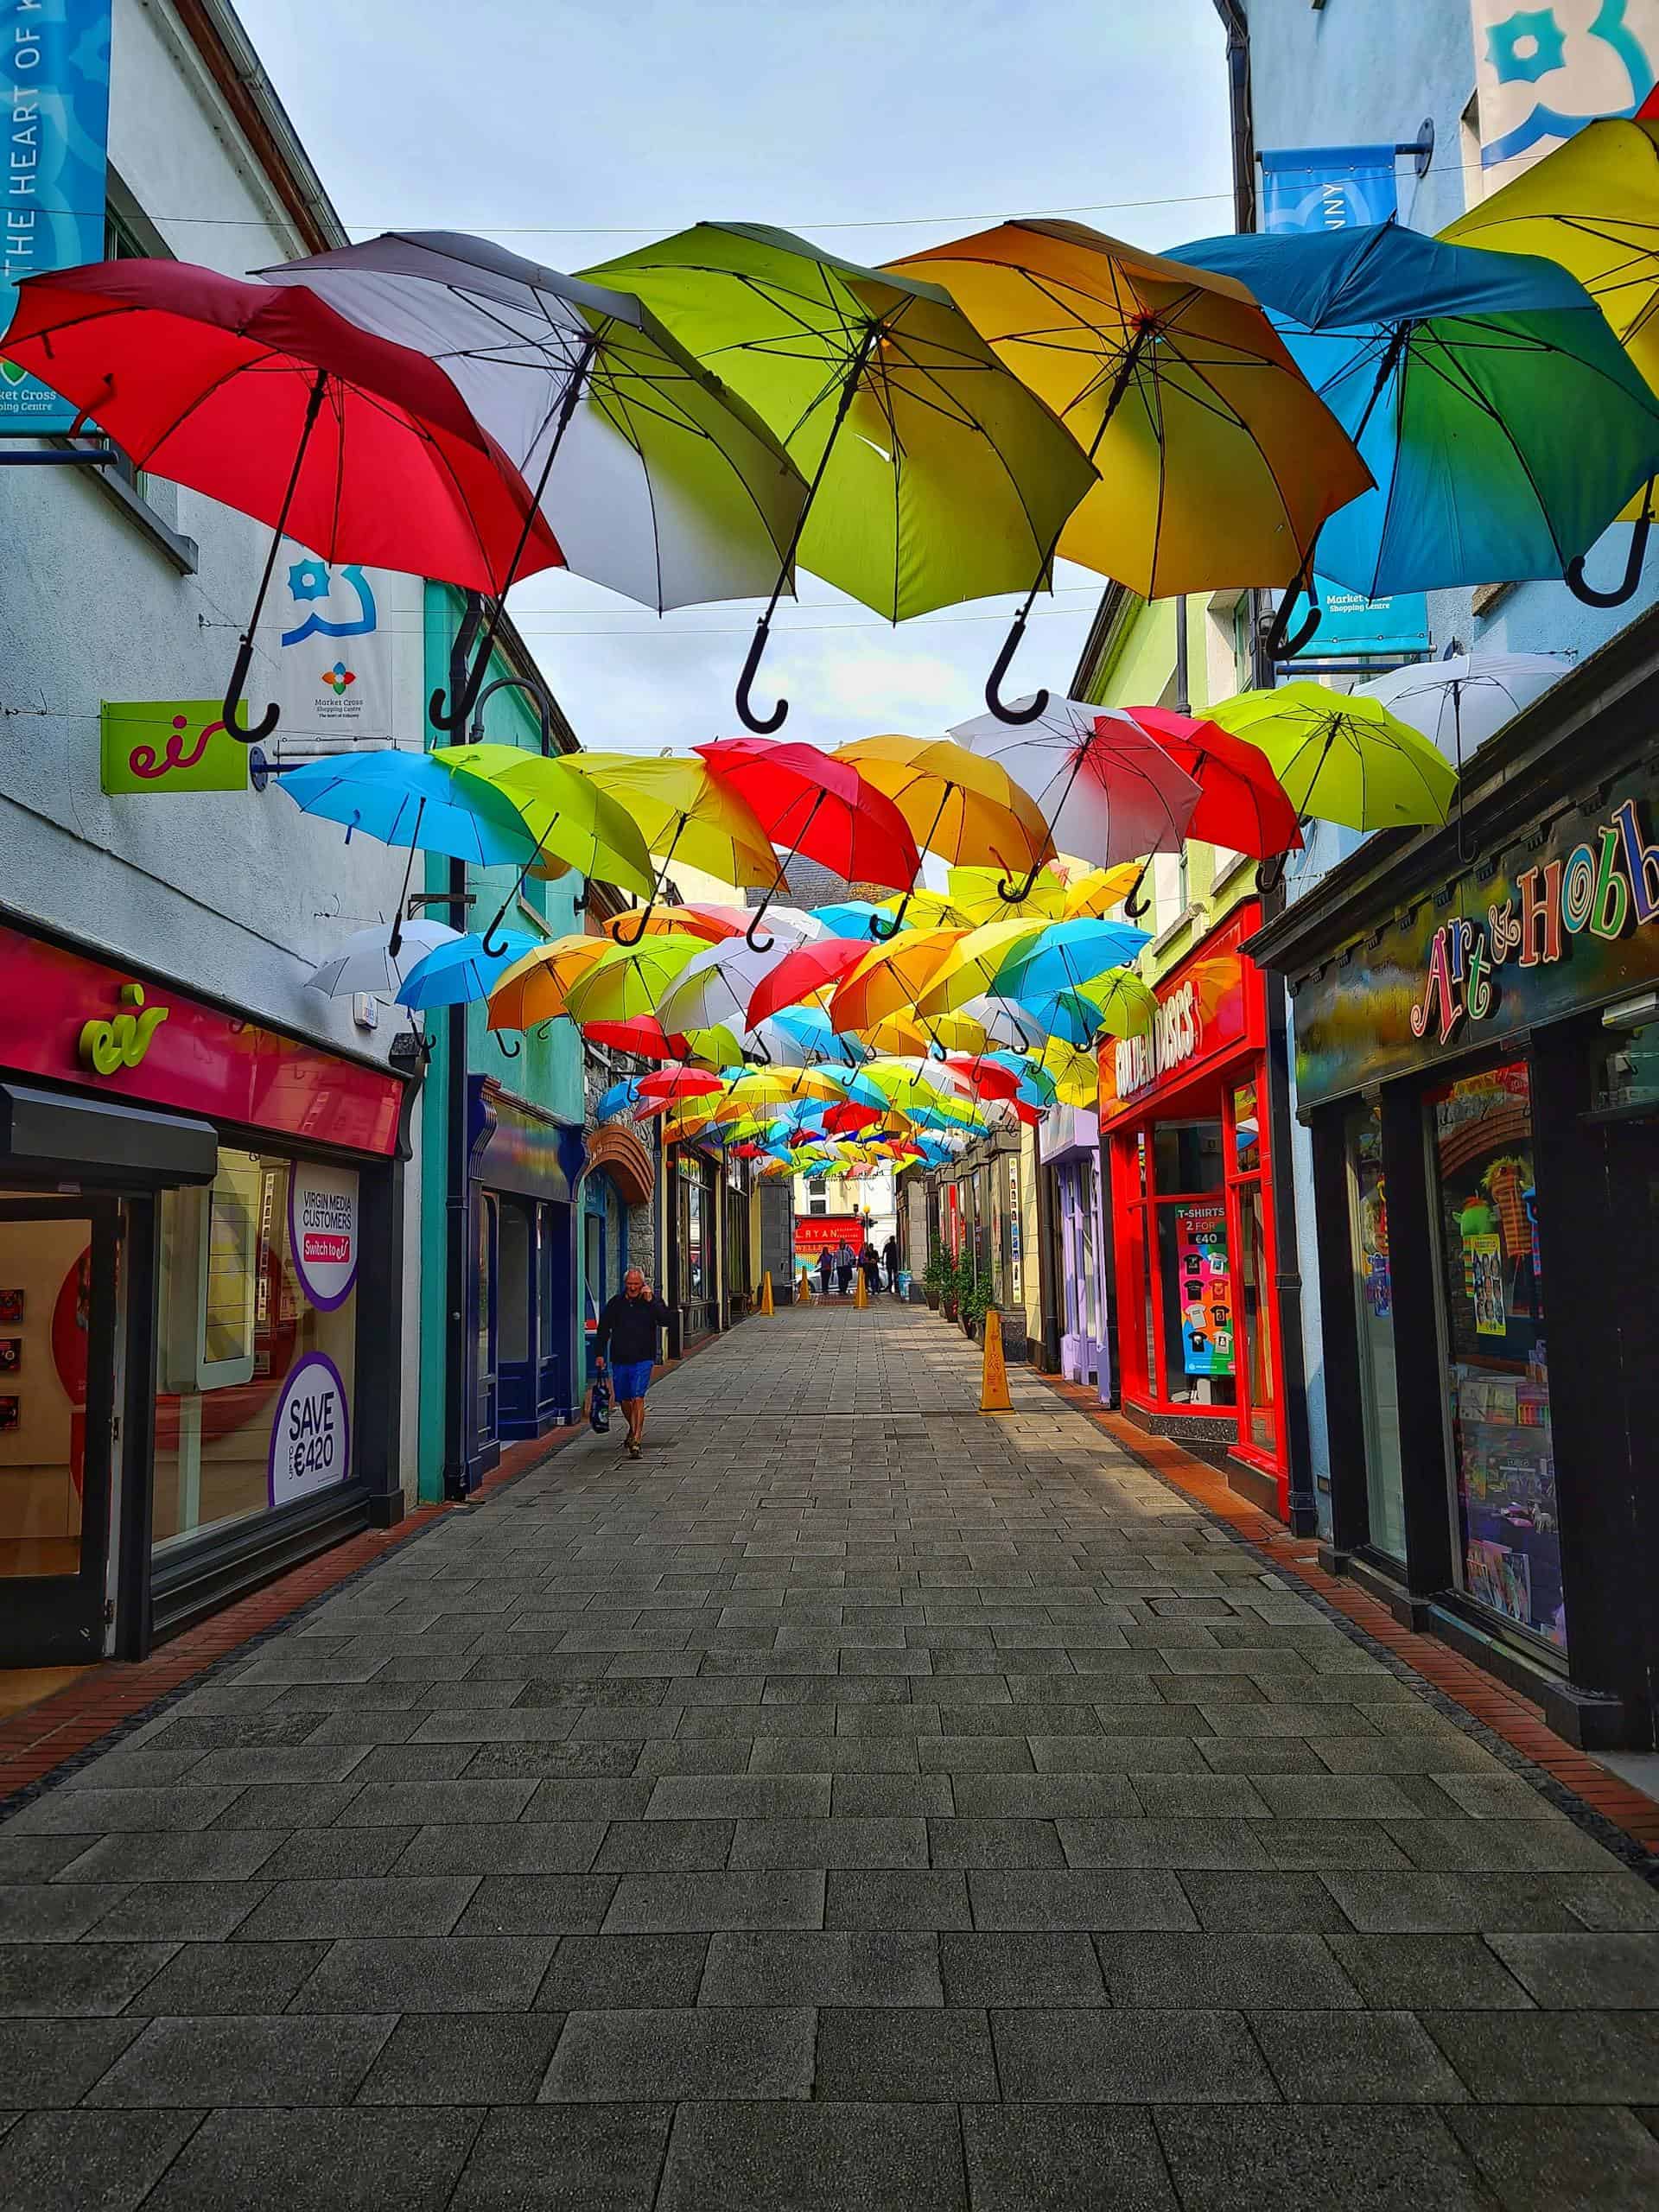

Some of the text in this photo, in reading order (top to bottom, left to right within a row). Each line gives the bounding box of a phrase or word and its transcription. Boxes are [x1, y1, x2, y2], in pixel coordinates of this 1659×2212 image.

[15, 27, 41, 69] OF
[9, 85, 40, 194] HEART
[4, 210, 35, 277] THE
[21, 389, 56, 401] Cross
[21, 402, 52, 411] Centre
[1326, 594, 1363, 605] Market
[1329, 603, 1365, 613] Shopping
[130, 715, 226, 779] eir
[1410, 917, 1491, 1046] Art
[1488, 899, 1522, 965] &
[79, 983, 169, 1075] eir
[1154, 981, 1195, 1075] DISCS
[303, 1191, 352, 1213] VIRGIN MEDIA
[1178, 1207, 1225, 1218] T-SHIRTS
[302, 1209, 352, 1230] CUSTOMERS
[1185, 1220, 1217, 1231] 2 FOR
[305, 1239, 328, 1256] Switch
[328, 1243, 336, 1256] to
[1195, 1233, 1217, 1244] €40
[289, 1391, 335, 1441] SAVE
[294, 1433, 334, 1478] €420
